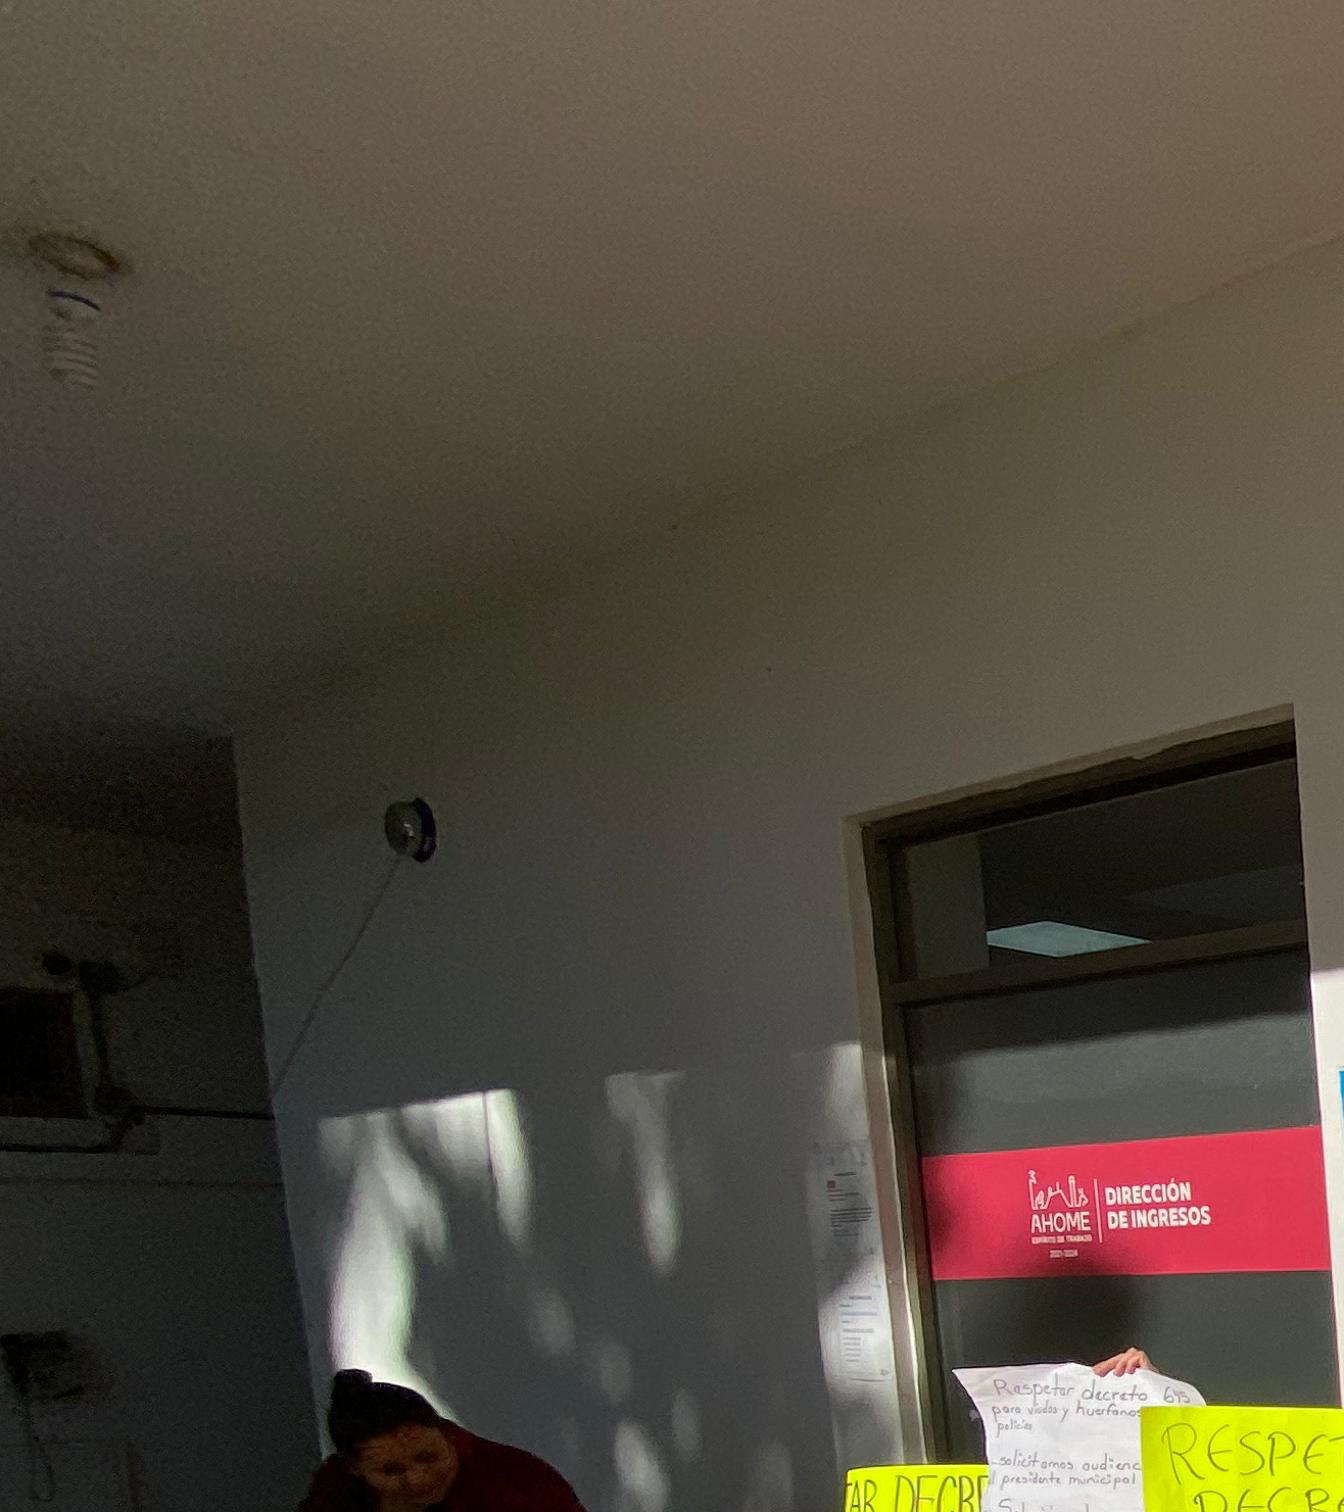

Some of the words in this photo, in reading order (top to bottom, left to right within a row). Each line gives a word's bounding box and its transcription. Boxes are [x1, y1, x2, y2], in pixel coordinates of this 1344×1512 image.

[1105, 1178, 1191, 1206] DIRECCIÓN
[1031, 1211, 1091, 1234] AHOME
[1107, 1210, 1129, 1230] DE
[1132, 1206, 1212, 1229] INGRESOS
[1163, 1386, 1192, 1404] 645
[992, 1405, 1021, 1423] para
[1059, 1408, 1069, 1424] y
